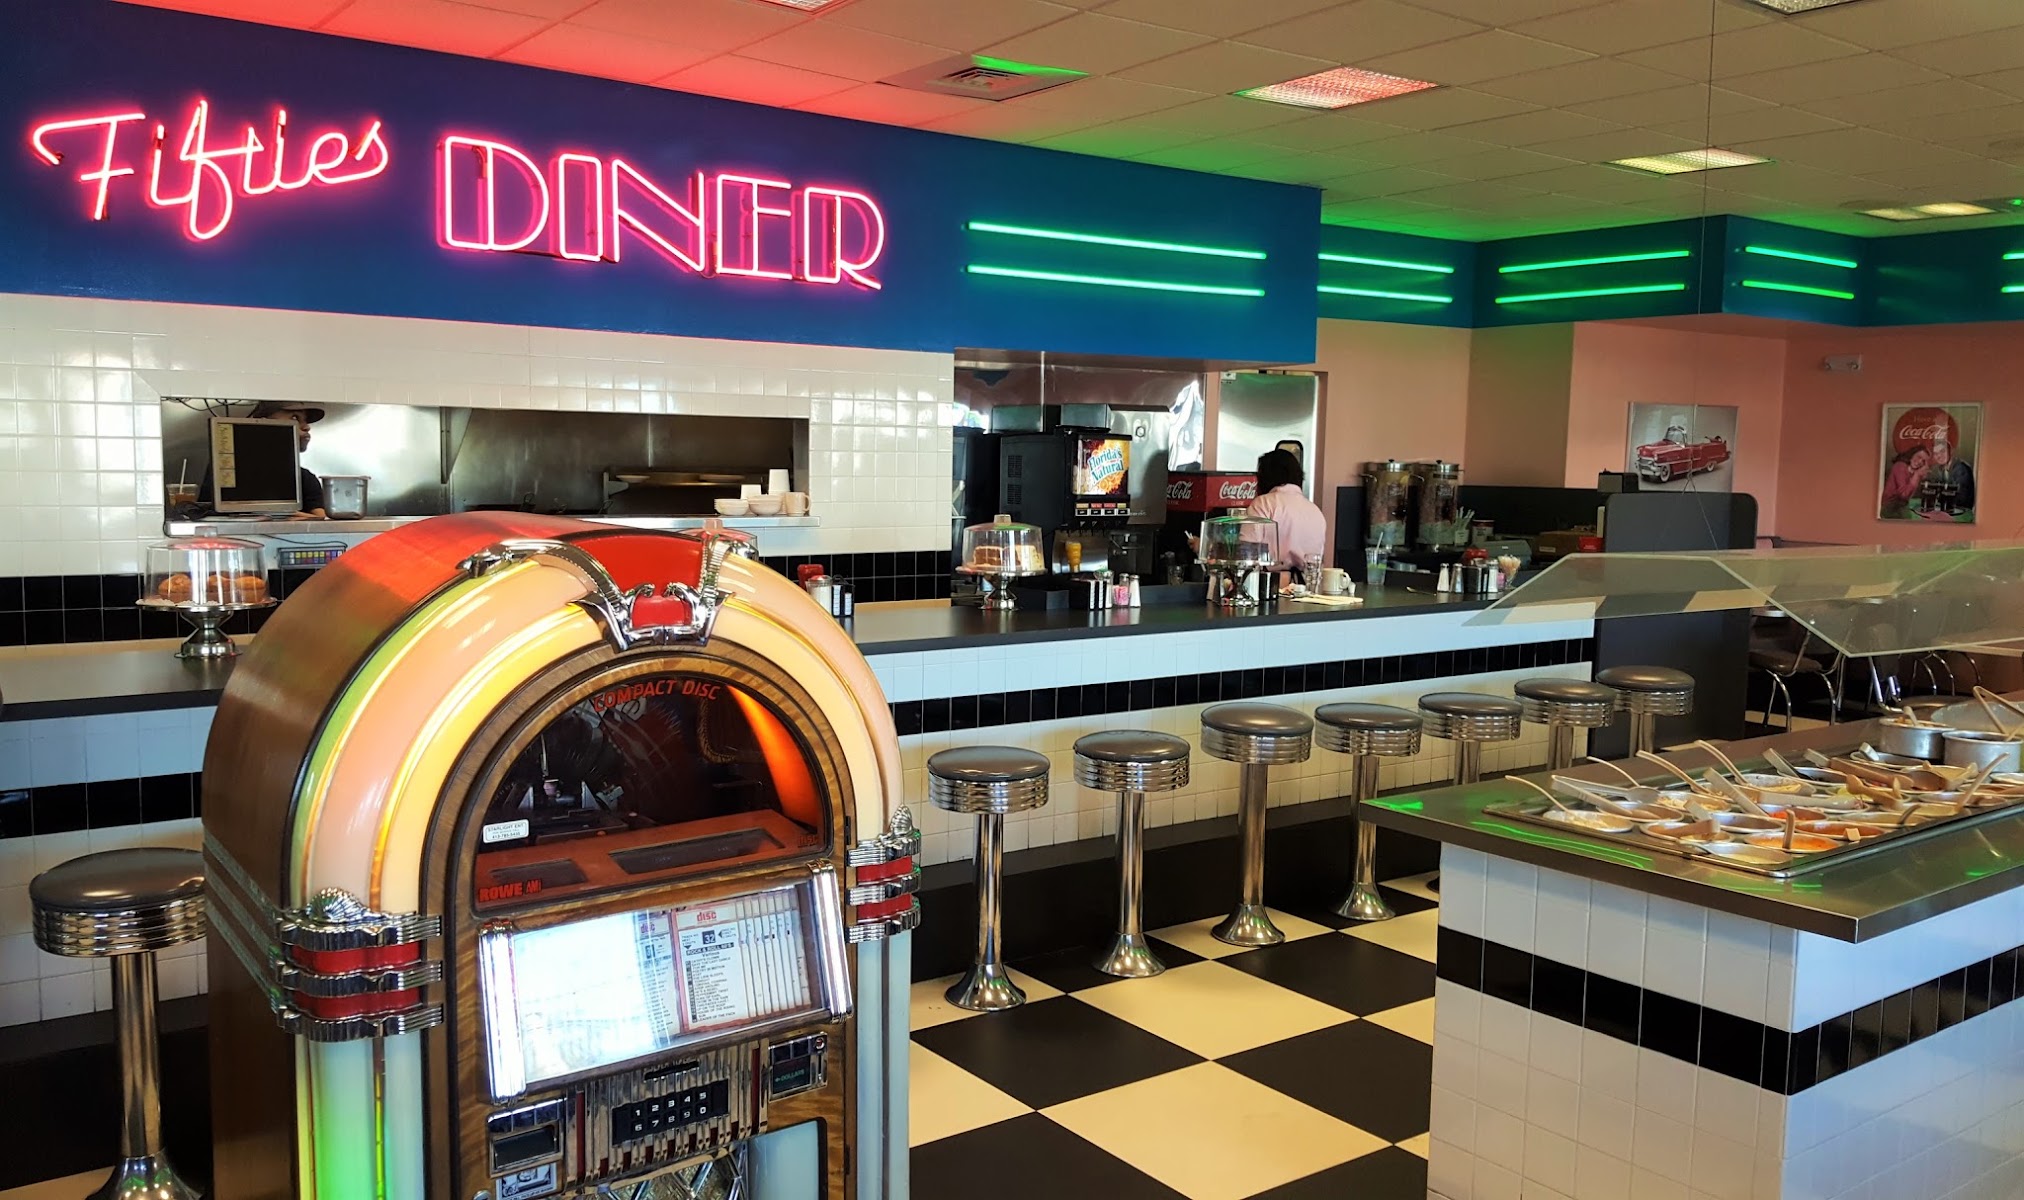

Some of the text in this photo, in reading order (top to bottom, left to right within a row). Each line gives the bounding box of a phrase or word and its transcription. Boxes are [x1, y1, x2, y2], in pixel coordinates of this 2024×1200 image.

[32, 99, 886, 291] Fifties DINER
[1088, 448, 1123, 471] Florida's
[1091, 460, 1124, 481] Natural
[593, 679, 720, 713] COMPACT DISC
[479, 882, 523, 902] ROWE
[696, 911, 717, 921] disc
[704, 934, 716, 944] 32
[635, 1091, 707, 1117] 1 2 3 4 5
[634, 1106, 707, 1132] 6 7 8 9 0
